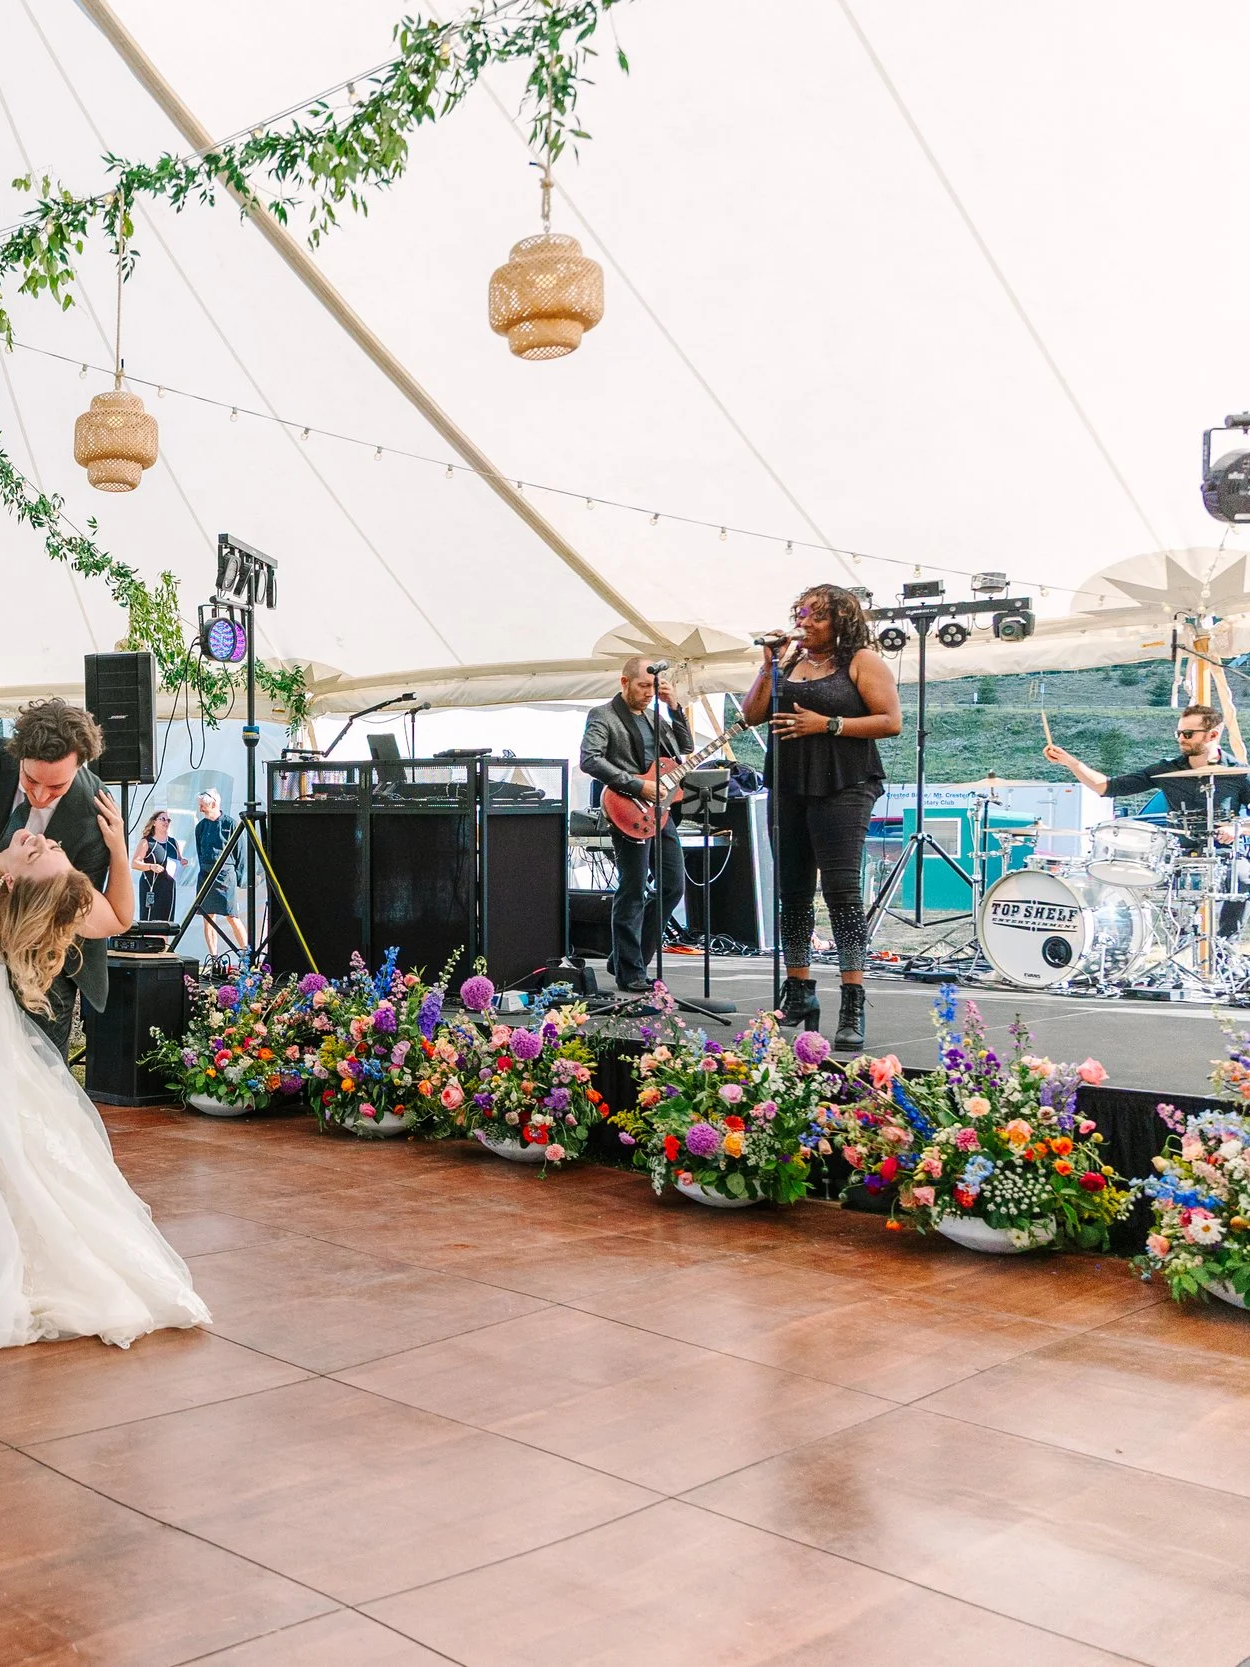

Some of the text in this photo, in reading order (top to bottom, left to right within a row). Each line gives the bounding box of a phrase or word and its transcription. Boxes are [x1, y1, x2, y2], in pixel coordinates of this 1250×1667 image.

[992, 903, 1078, 922] TOP SHELF
[992, 918, 1078, 929] ENTERTAINMENT
